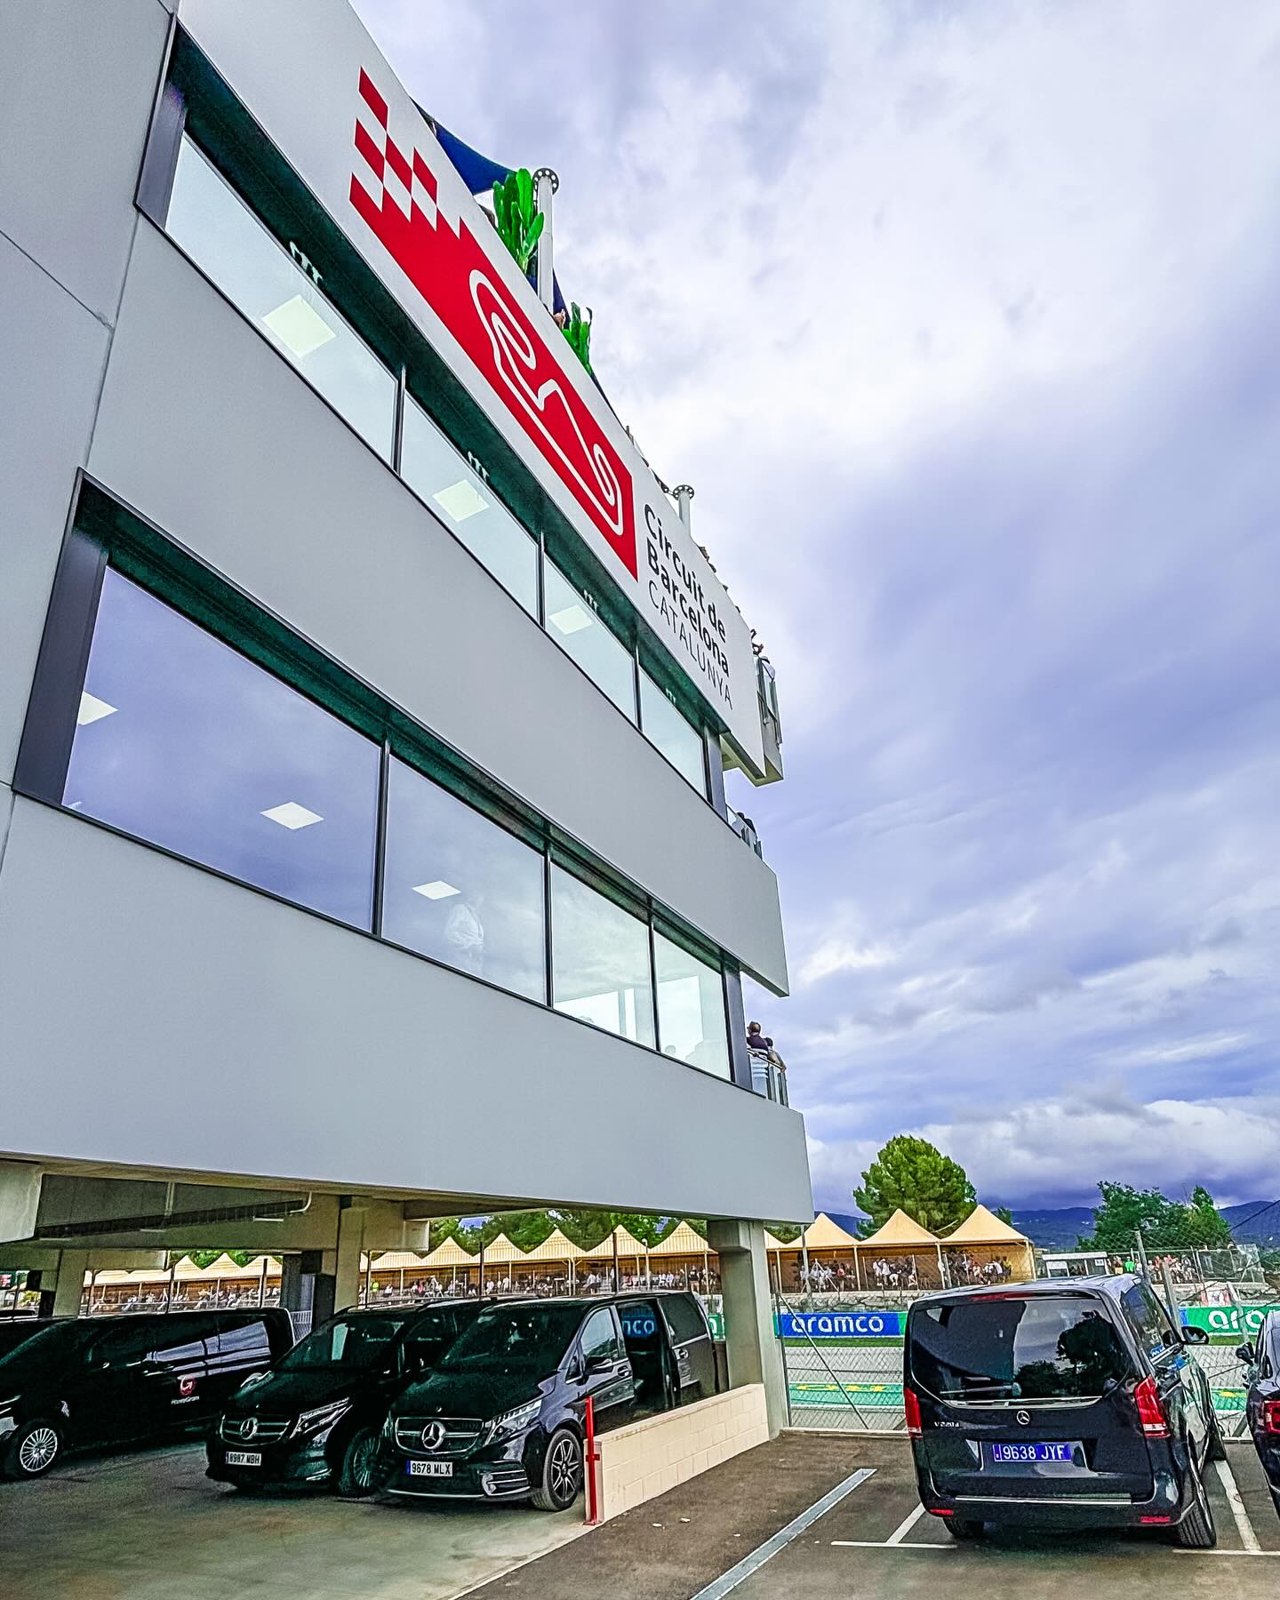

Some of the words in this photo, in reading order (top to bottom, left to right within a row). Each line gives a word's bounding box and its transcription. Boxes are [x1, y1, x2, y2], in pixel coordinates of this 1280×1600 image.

[644, 503, 704, 614] Circuit
[708, 601, 726, 643] de
[646, 537, 730, 678] Barcelona
[648, 579, 733, 711] CATALUNYA
[791, 1316, 884, 1333] aramco
[411, 1462, 432, 1474] 9678
[433, 1463, 451, 1475] MLX
[1002, 1445, 1037, 1460] 9638
[1041, 1445, 1065, 1460] JYF
